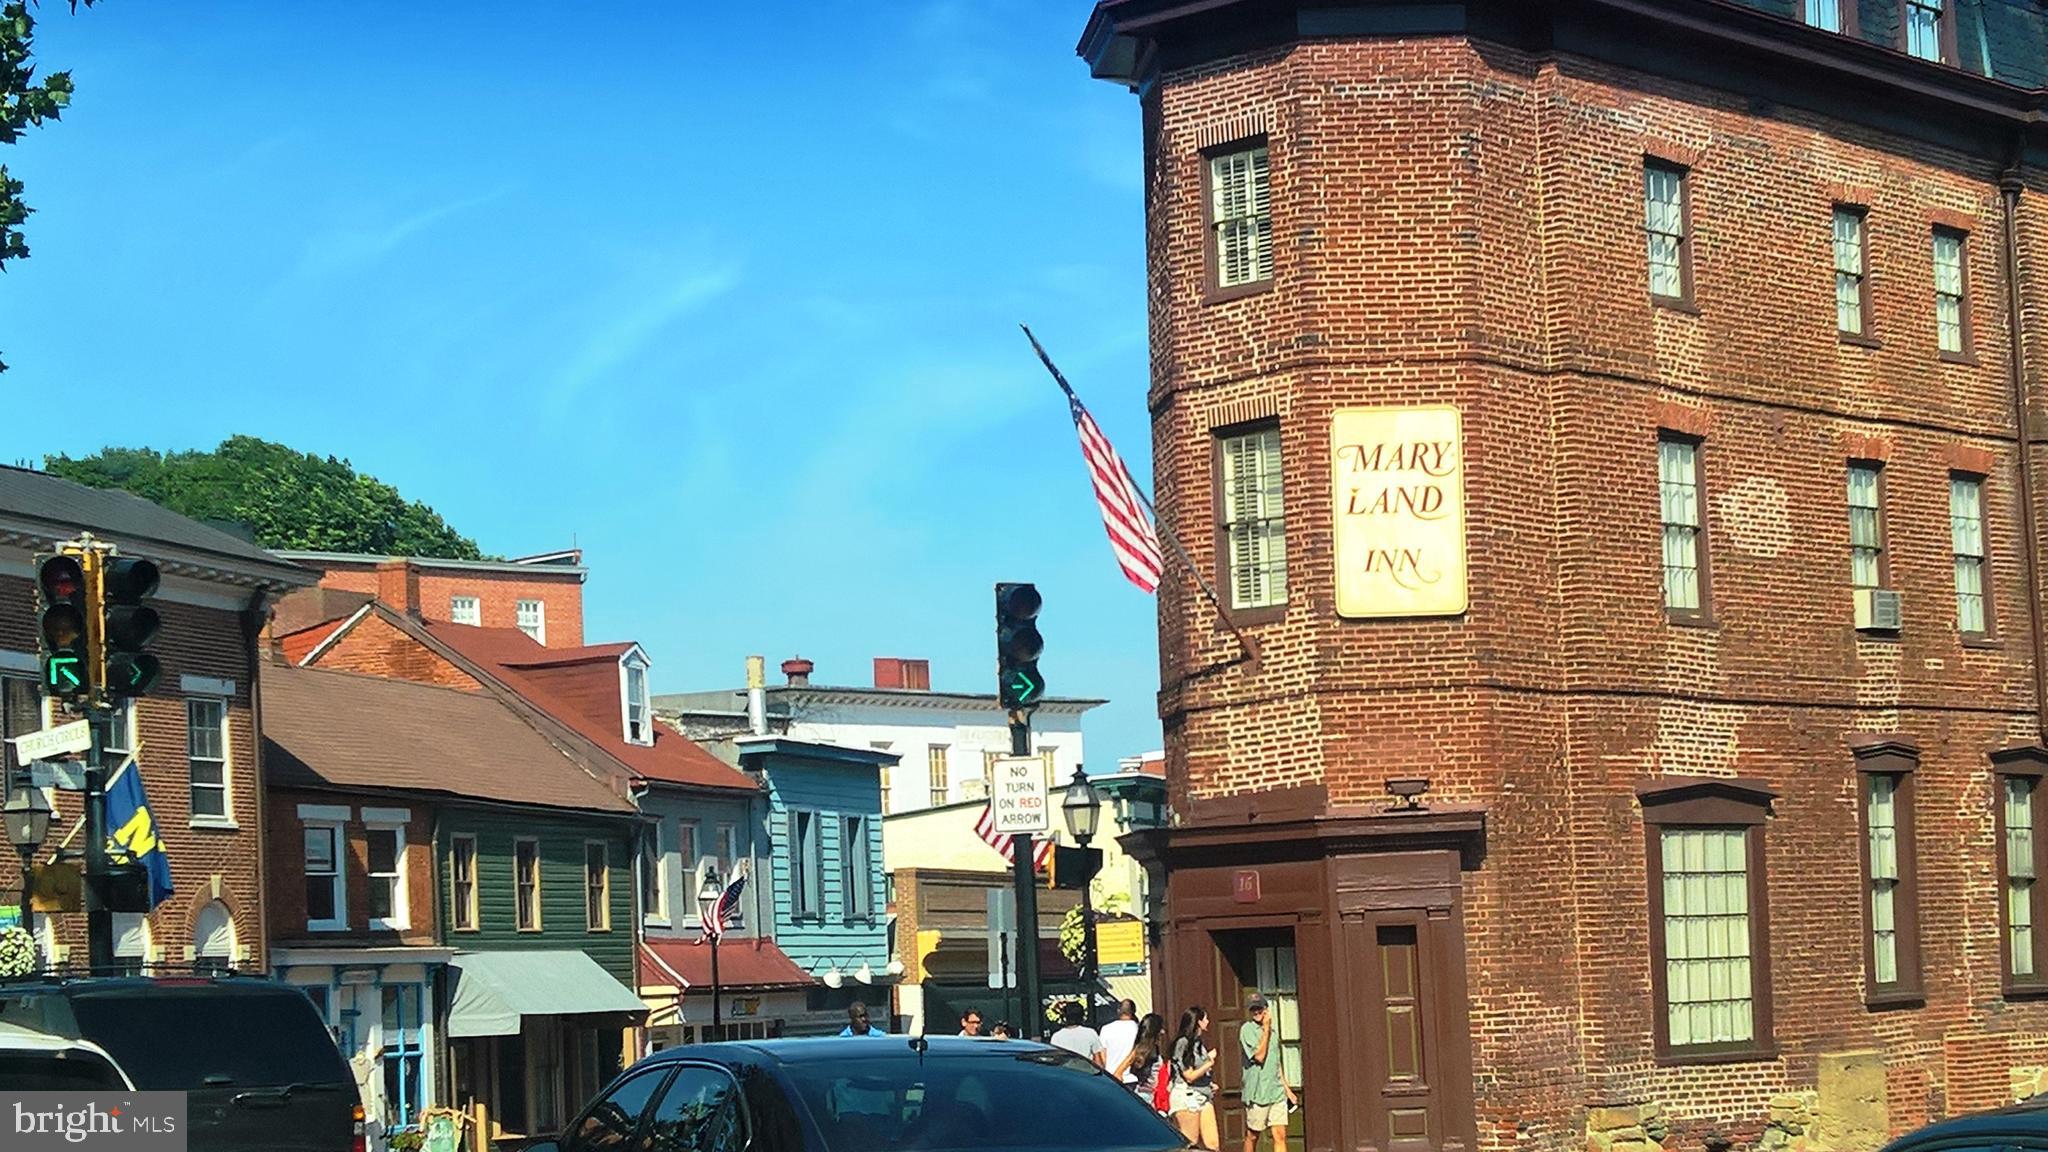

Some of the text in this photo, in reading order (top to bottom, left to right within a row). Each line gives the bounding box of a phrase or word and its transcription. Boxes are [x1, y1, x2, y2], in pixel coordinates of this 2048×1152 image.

[1337, 441, 1456, 477] MARY
[1346, 485, 1449, 521] LAND
[1364, 548, 1441, 590] INN
[1010, 766, 1027, 777] NO
[1005, 782, 1035, 793] TURN
[999, 797, 1042, 809] ON RED
[1002, 813, 1041, 825] ARROW
